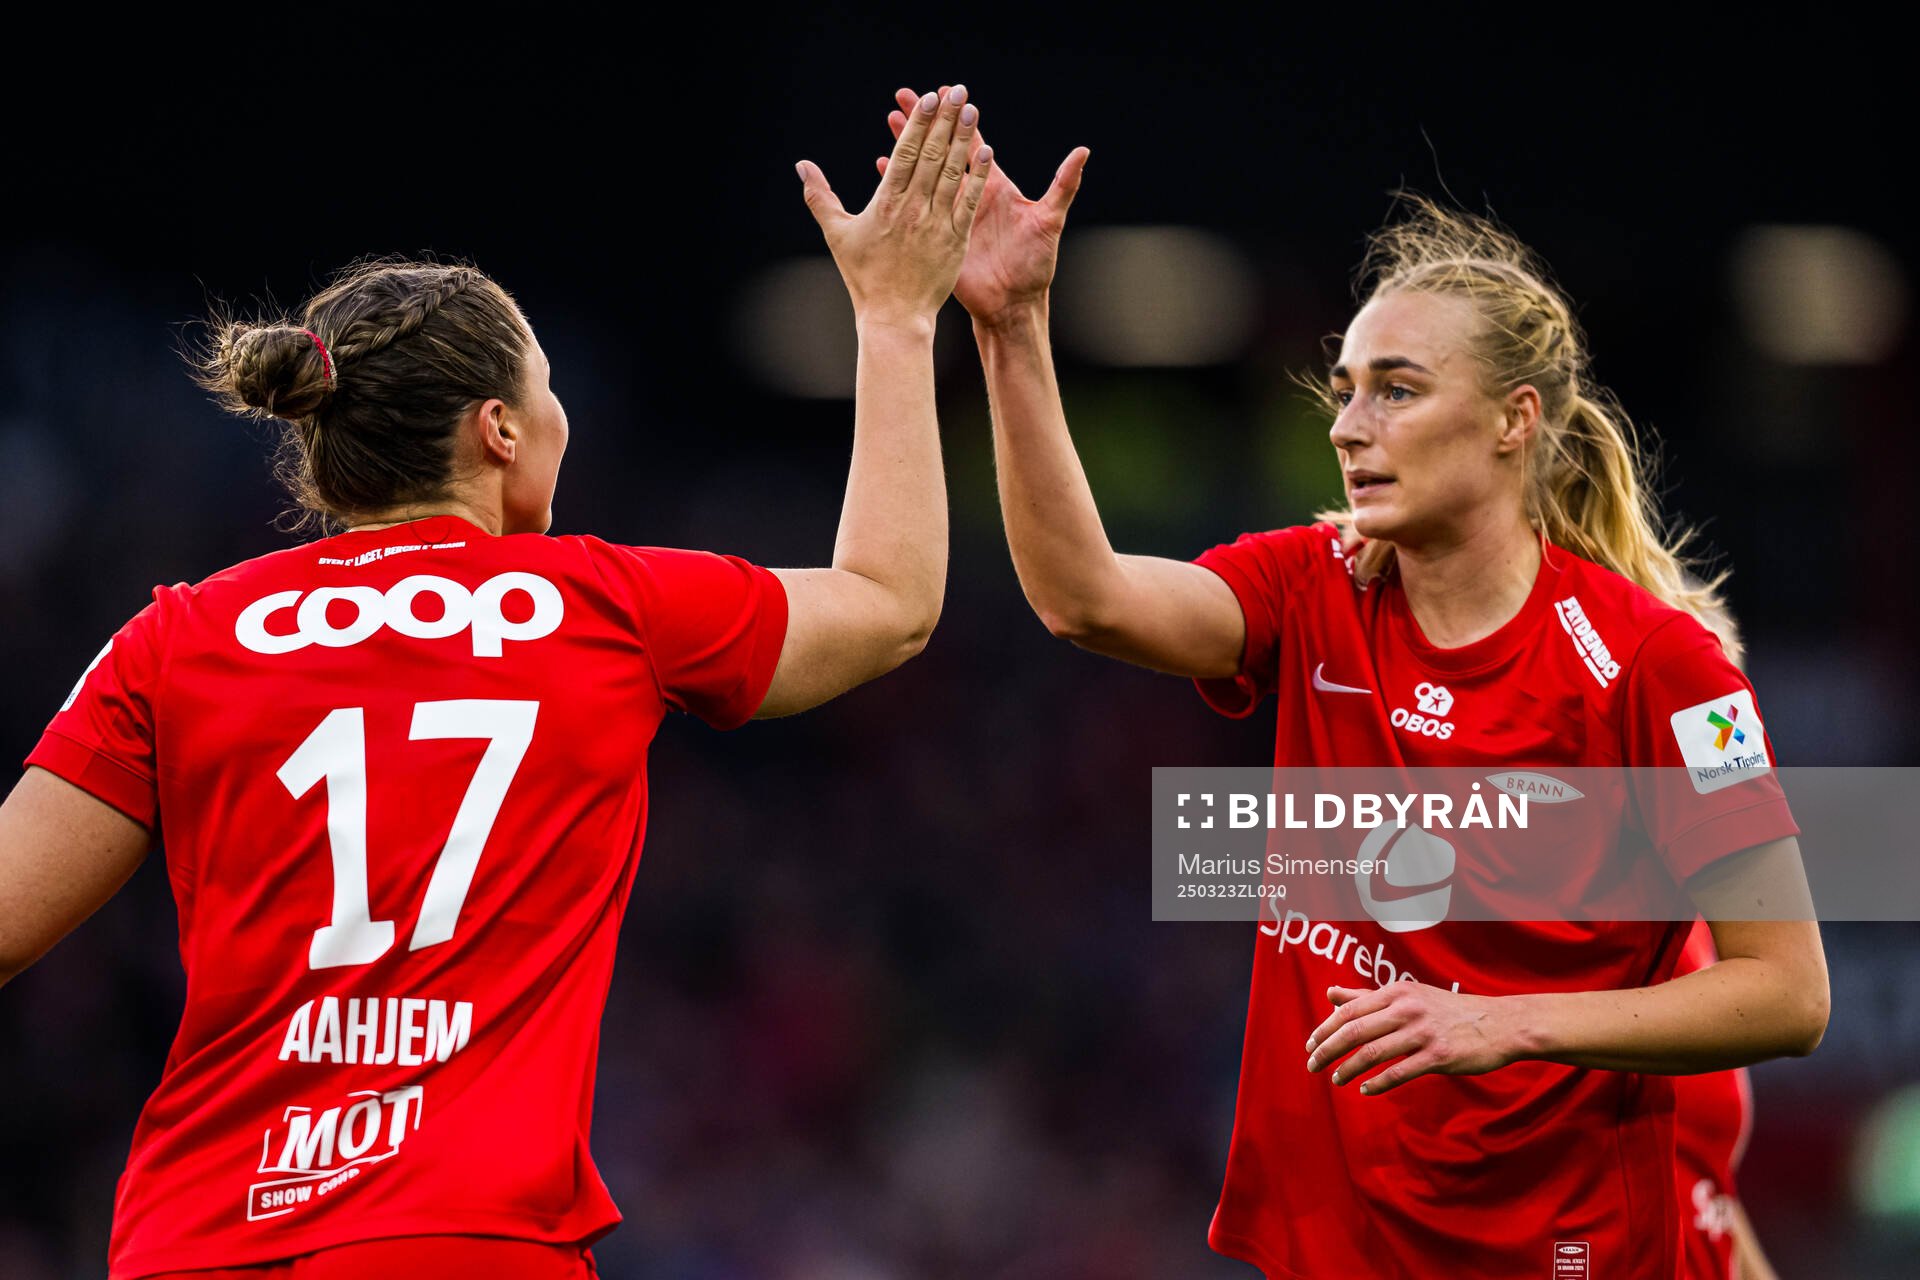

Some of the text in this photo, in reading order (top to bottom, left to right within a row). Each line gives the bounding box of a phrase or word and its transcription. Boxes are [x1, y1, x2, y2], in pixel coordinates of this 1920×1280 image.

[235, 572, 564, 657] coop
[1390, 707, 1455, 740] OBOS
[1506, 776, 1564, 799] BRANN
[1696, 761, 1733, 783] Norsk
[276, 699, 539, 969] 17
[278, 996, 474, 1066] AAHJEM
[277, 1086, 424, 1170] MOT
[260, 1185, 313, 1209] SHOW
